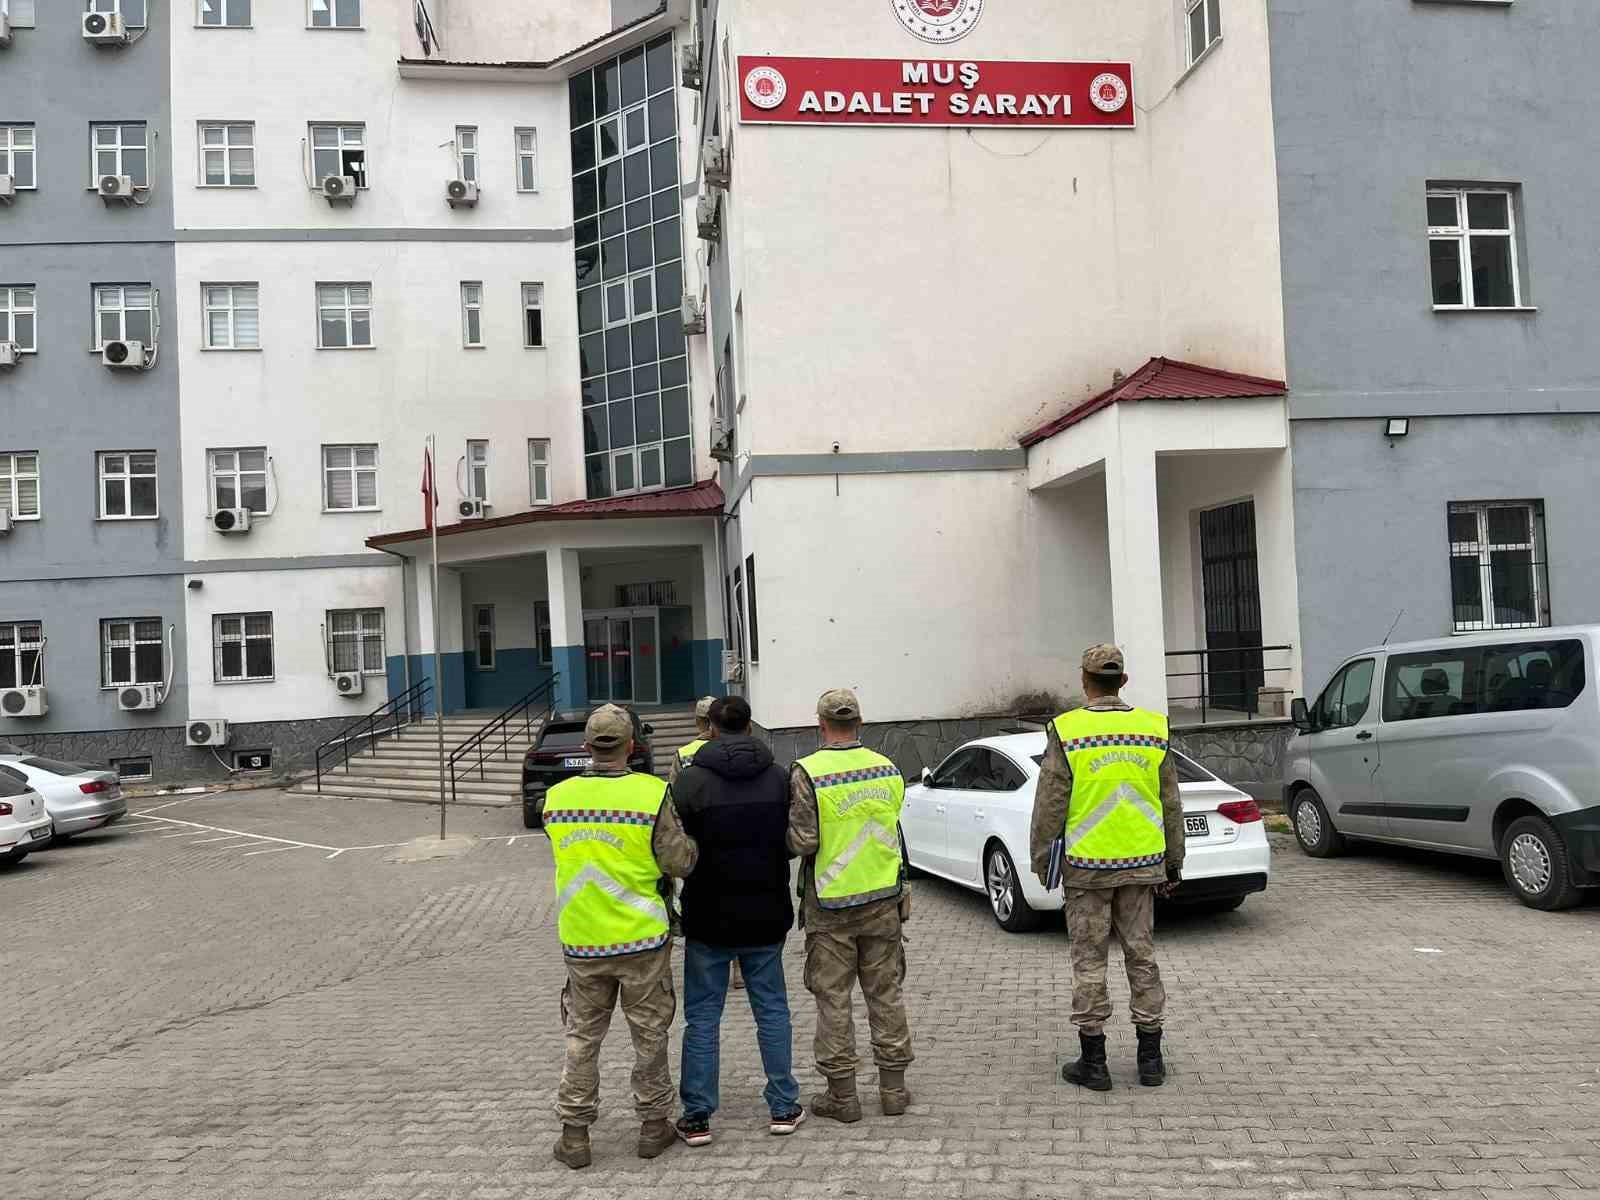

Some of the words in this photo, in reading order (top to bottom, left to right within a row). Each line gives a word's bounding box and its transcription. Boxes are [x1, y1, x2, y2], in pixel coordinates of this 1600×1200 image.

[902, 62, 979, 89] MUŞ
[799, 91, 935, 113] ADALET
[949, 93, 1072, 114] SARAYI
[1185, 817, 1206, 832] 668
